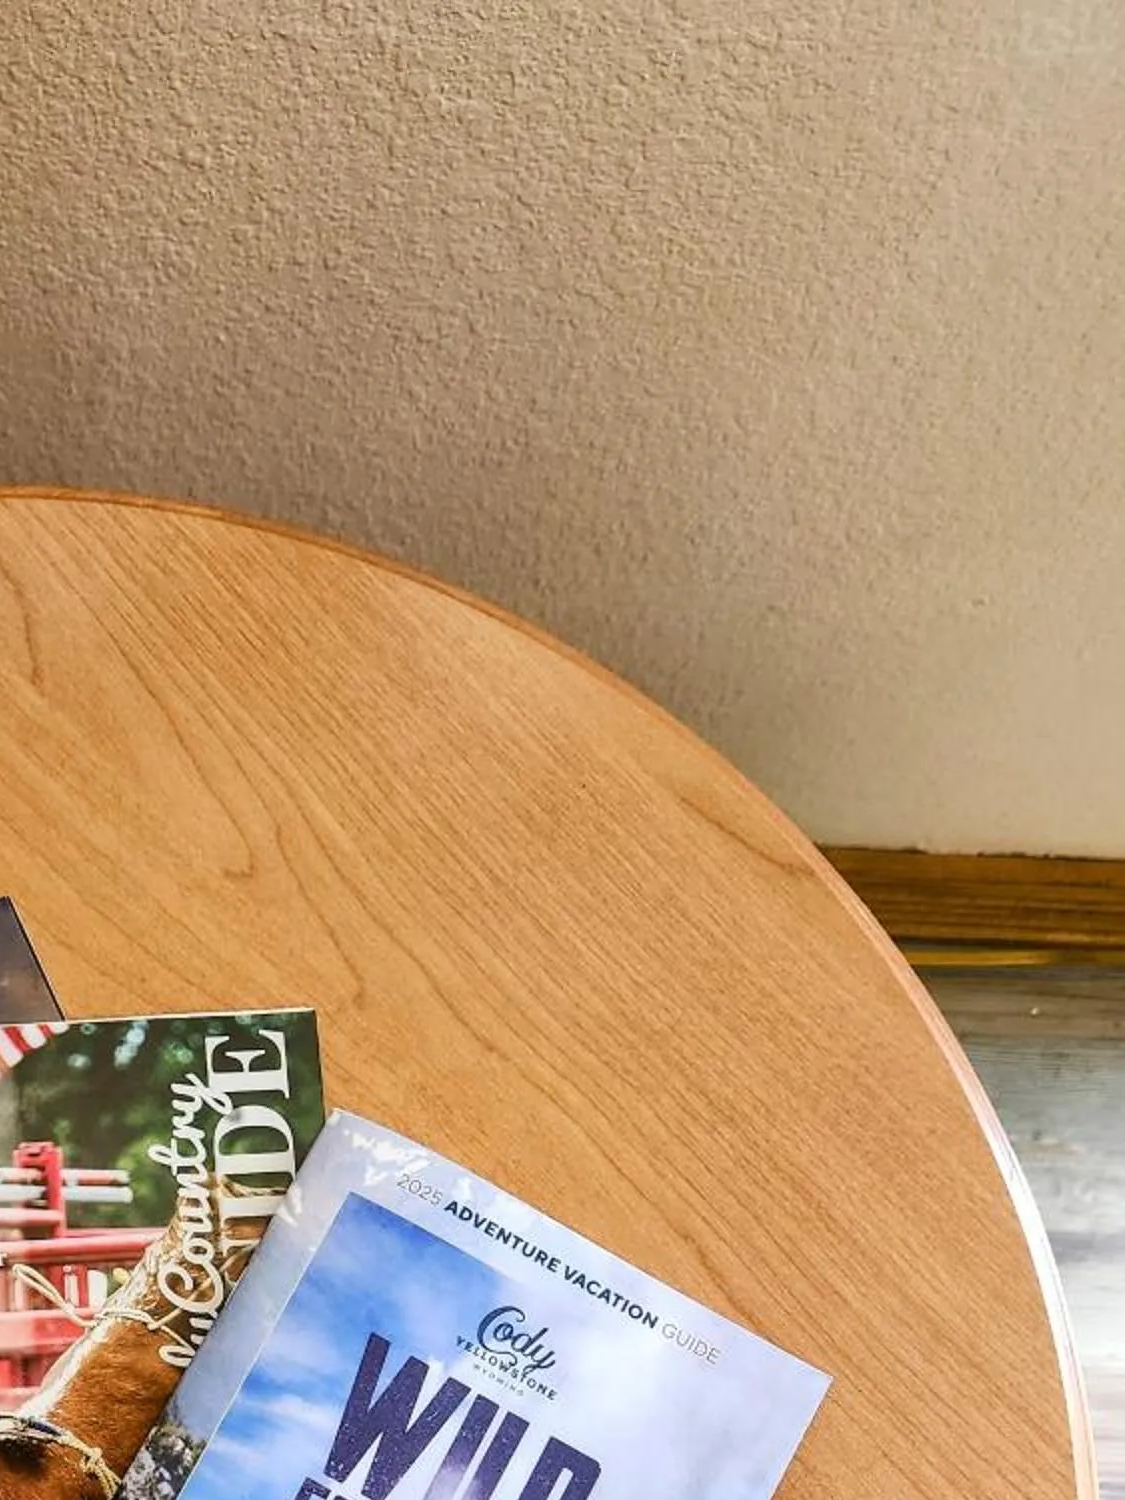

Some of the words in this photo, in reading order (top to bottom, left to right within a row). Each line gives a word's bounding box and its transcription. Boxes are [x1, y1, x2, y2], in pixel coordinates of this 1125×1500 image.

[148, 1073, 232, 1317] Country
[205, 1029, 296, 1257] IDE
[396, 1173, 444, 1206] 2025
[443, 1199, 562, 1274] ADVENTURE
[563, 1265, 659, 1329] VACATION
[661, 1322, 721, 1366] GUIDE
[477, 1306, 556, 1382] Cody
[456, 1335, 558, 1401] YELLOWSTONE
